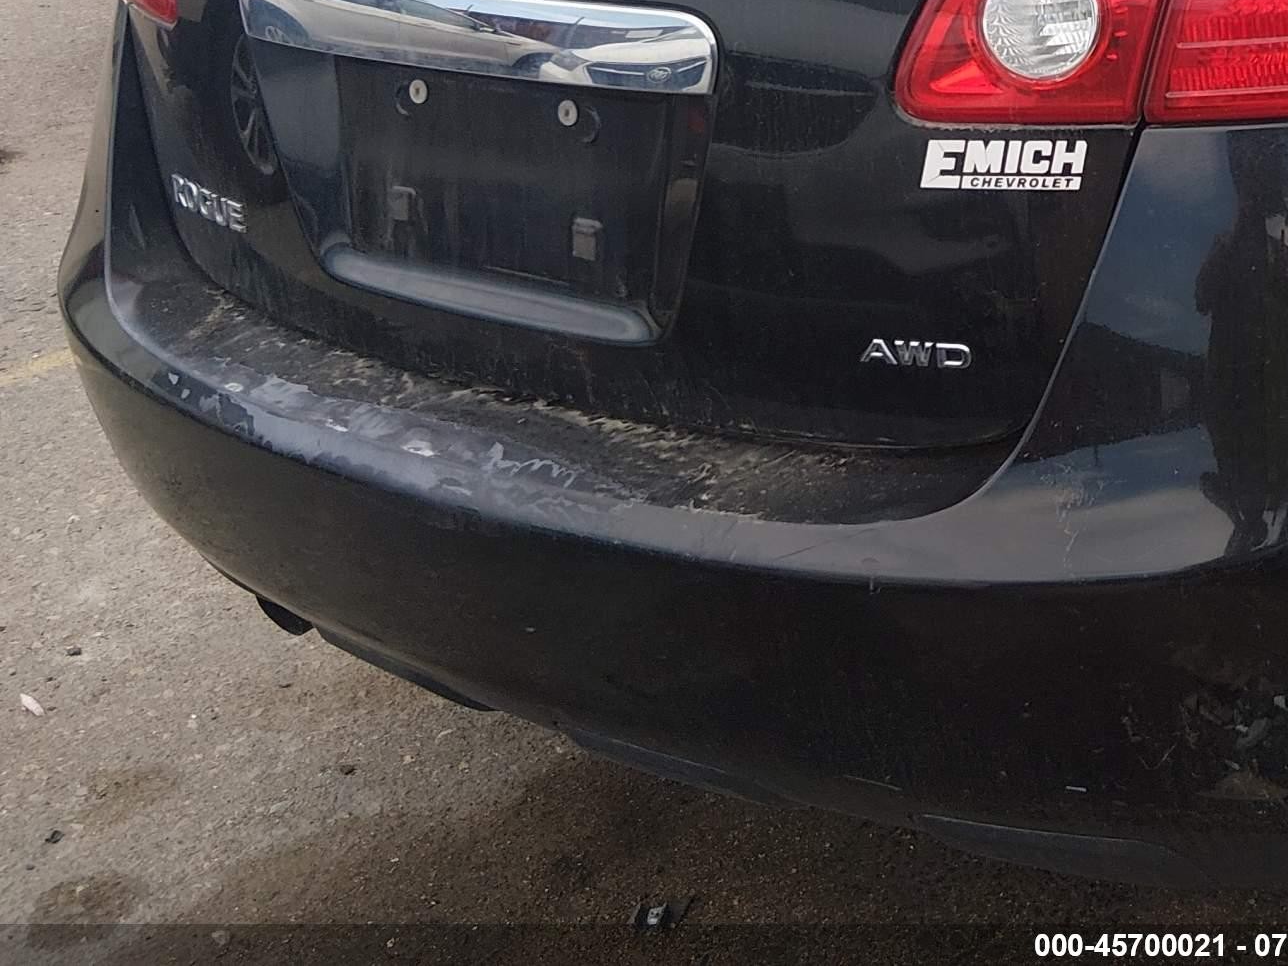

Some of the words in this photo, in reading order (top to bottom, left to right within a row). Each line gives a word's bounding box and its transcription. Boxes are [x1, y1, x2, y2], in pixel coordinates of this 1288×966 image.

[920, 139, 1088, 189] EMICH
[970, 177, 1075, 188] CHEVROLET
[171, 174, 247, 233] ROGUE
[860, 338, 972, 368] AWD
